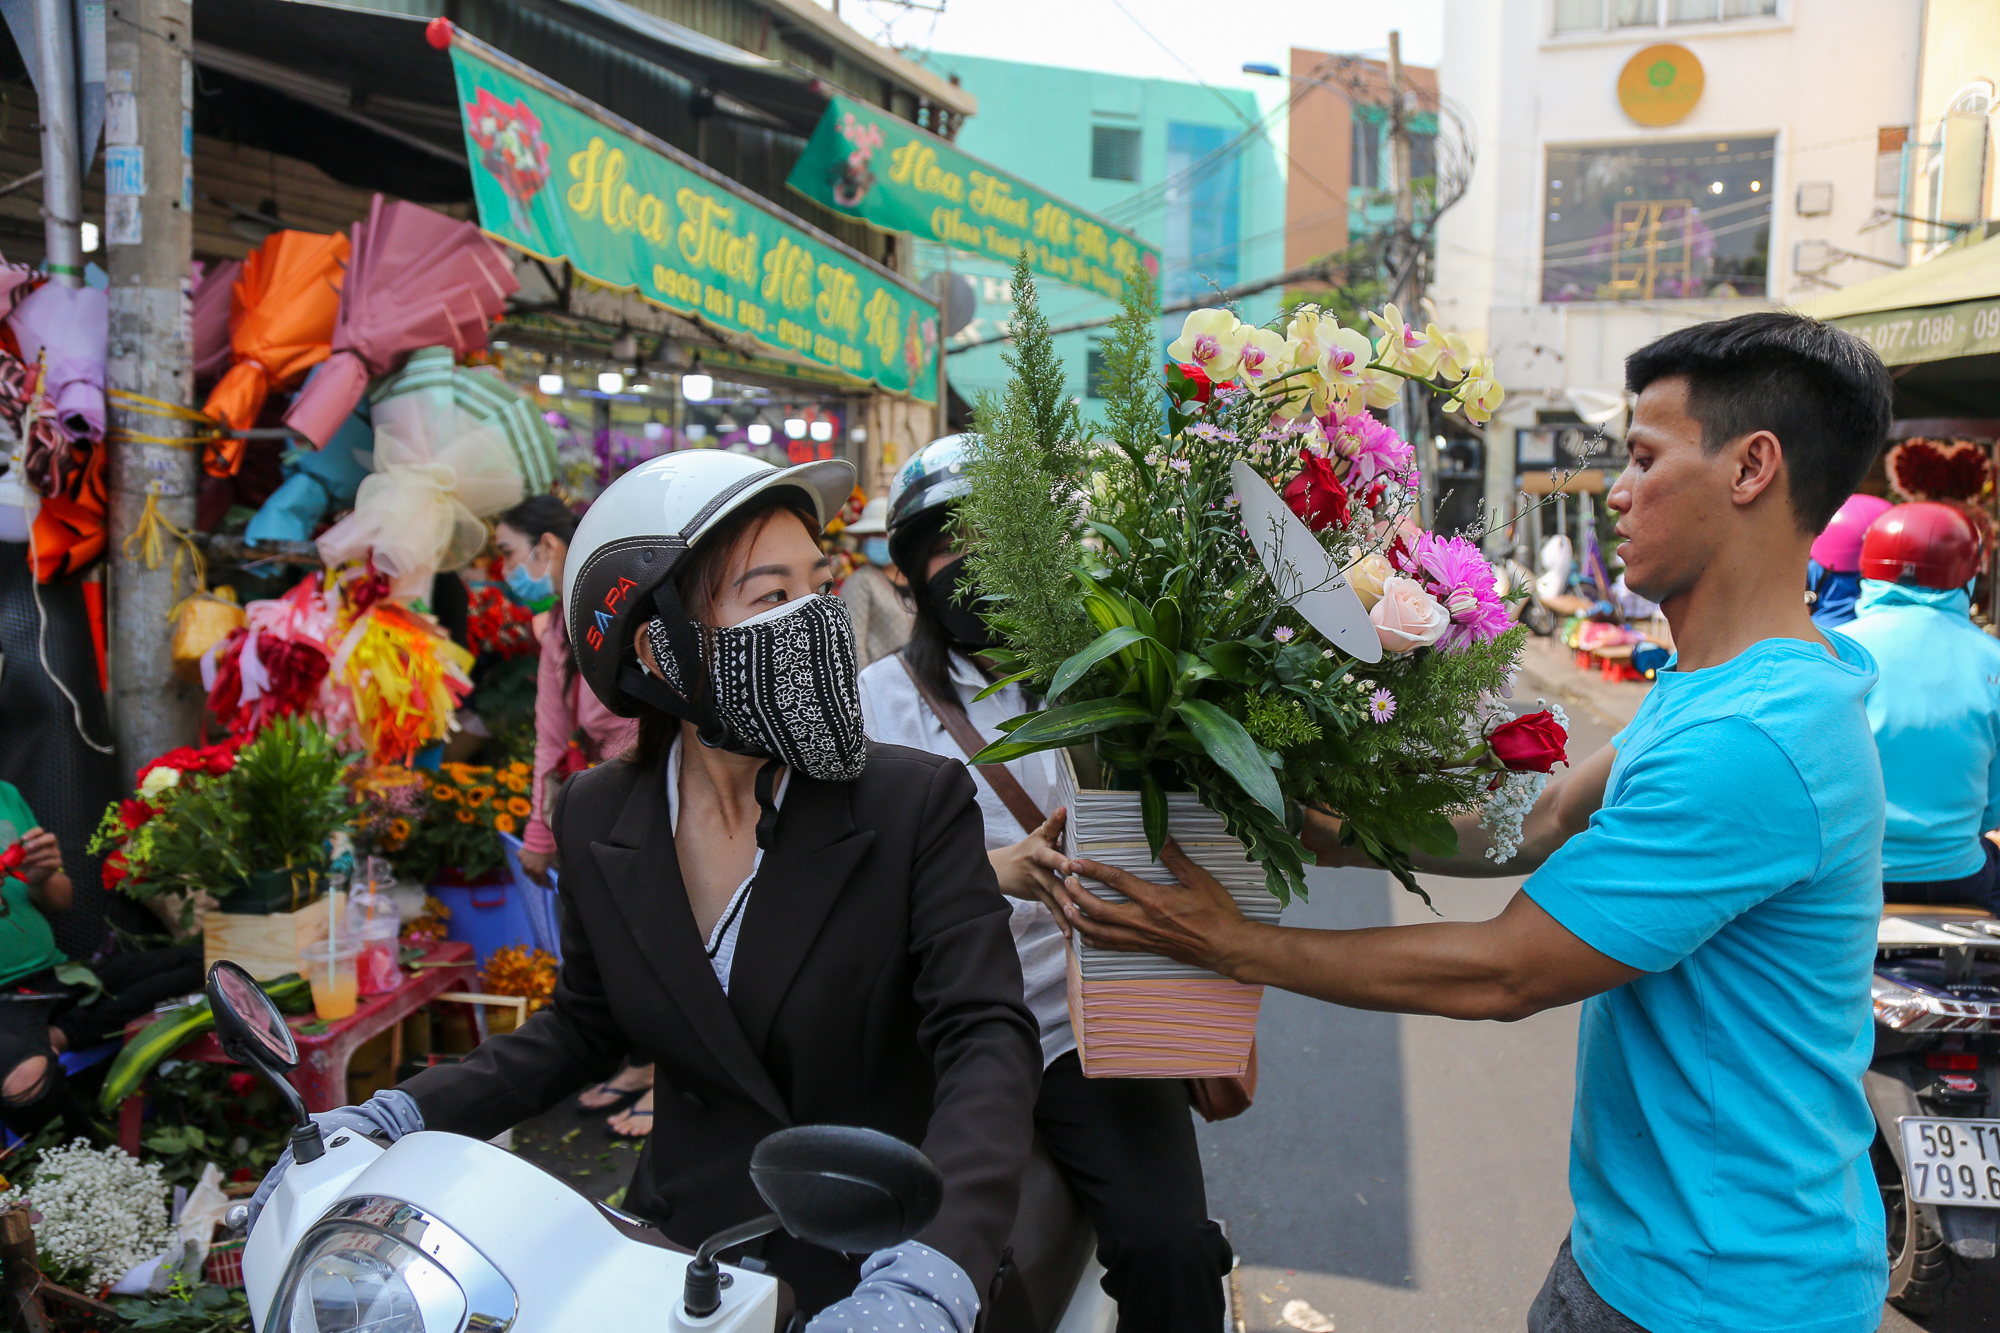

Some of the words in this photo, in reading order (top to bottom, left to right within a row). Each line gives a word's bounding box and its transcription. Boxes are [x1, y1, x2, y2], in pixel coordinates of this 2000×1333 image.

[888, 139, 965, 203] Hoa
[567, 136, 670, 246] Hoa
[676, 187, 758, 286] Tươi
[761, 237, 814, 309] Hồ
[816, 263, 861, 341] Thị
[652, 263, 702, 306] 0903
[703, 284, 734, 320] 861
[767, 323, 776, 333] -
[586, 576, 638, 652] SAPA
